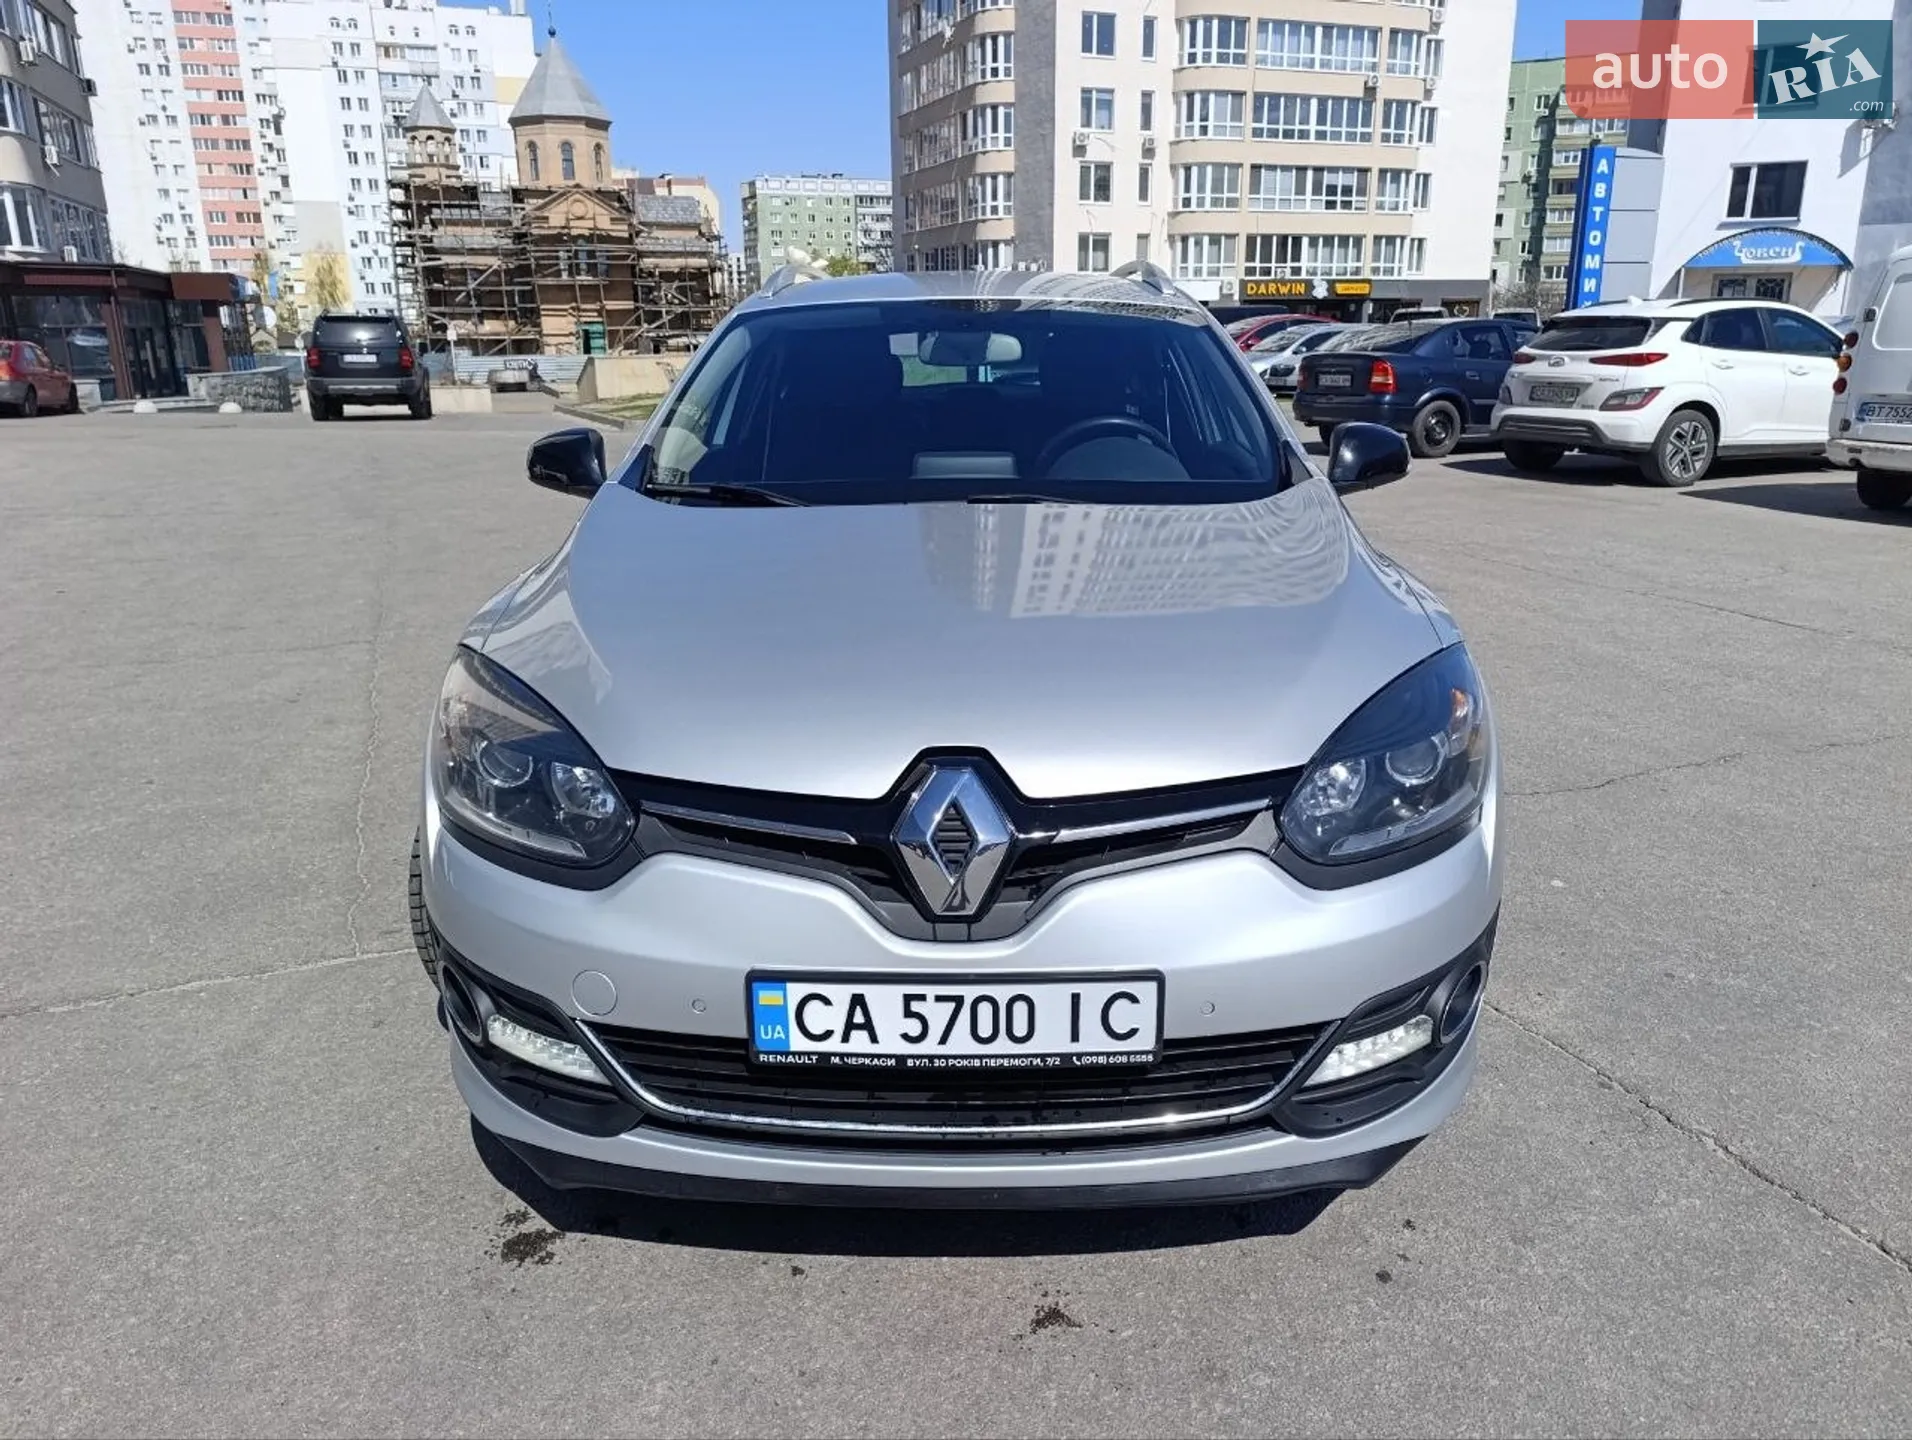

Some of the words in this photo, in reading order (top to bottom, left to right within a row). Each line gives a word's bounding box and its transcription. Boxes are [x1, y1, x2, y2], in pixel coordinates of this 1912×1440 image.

[1582, 157, 1609, 307] АВТОМИ
[1247, 282, 1305, 295] DARWIN
[795, 992, 879, 1044] CA
[899, 993, 1036, 1046] 5700
[760, 1025, 786, 1040] UA
[759, 1054, 819, 1064] RENAULT
[830, 1056, 843, 1065] М.
[843, 1057, 896, 1066] ЧЕРКАСИ
[906, 1058, 932, 1067] ВУЛ.
[933, 1058, 947, 1066] 30
[948, 1058, 981, 1067] РОКІВ
[983, 1057, 1044, 1067] ПЕРЕМОГИ,
[1045, 1056, 1061, 1066] 7/2
